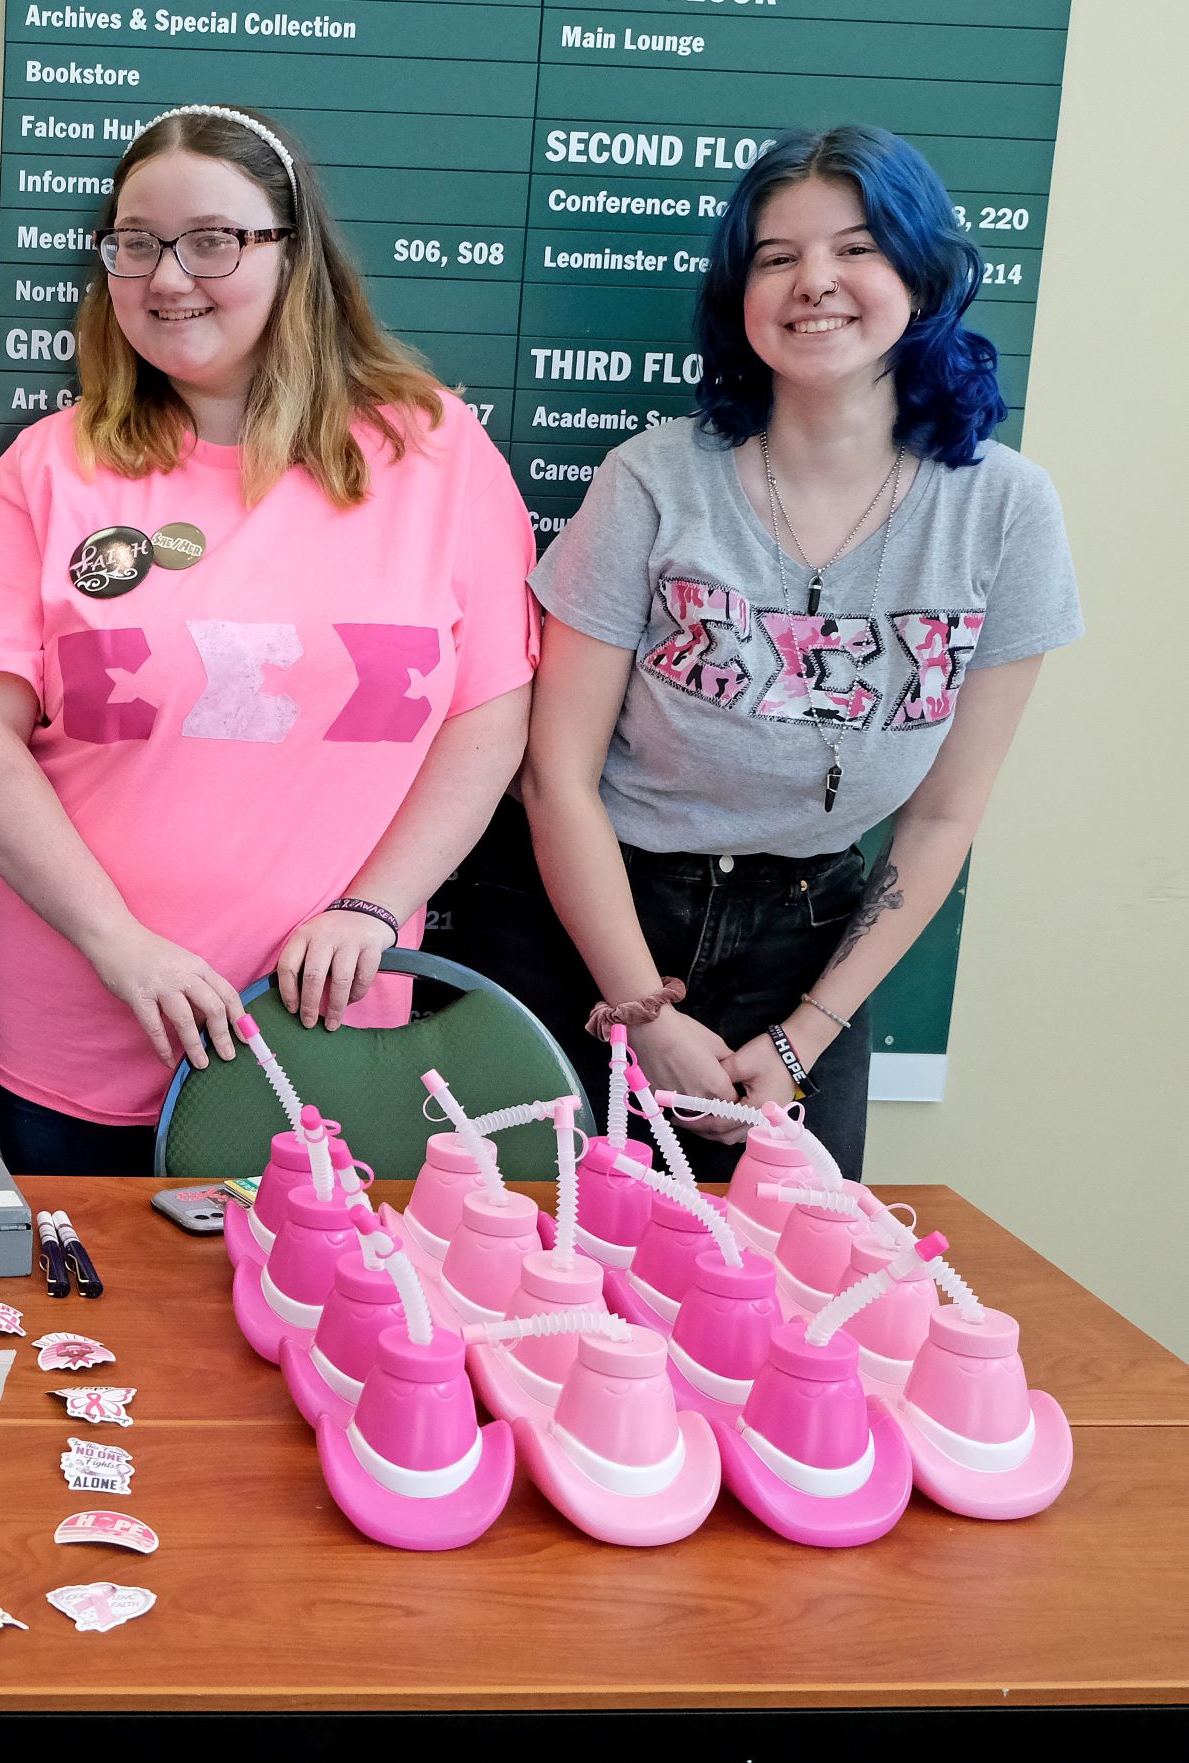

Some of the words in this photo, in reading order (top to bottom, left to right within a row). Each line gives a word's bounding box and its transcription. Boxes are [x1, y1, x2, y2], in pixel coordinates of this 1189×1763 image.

[25, 5, 122, 30] Archives
[129, 8, 147, 31] &
[154, 9, 237, 36] Special
[244, 13, 357, 39] Collection
[561, 25, 616, 50] Main
[623, 31, 705, 56] Lounge
[25, 60, 140, 87] Bookstore
[21, 115, 95, 140] Falcon
[544, 129, 684, 168] SECOND
[548, 189, 690, 217] Conference
[978, 207, 1029, 231] 220
[393, 239, 448, 266] S06,
[456, 241, 504, 264] S08
[543, 246, 668, 272] Leominster
[982, 262, 1023, 285] 214
[15, 279, 79, 303] North
[530, 348, 633, 382] THIRD
[11, 387, 49, 411] Art
[531, 405, 639, 431] Academic
[75, 1446, 95, 1457] NO
[97, 1450, 123, 1463] ONE
[72, 1475, 118, 1490] ALONE
